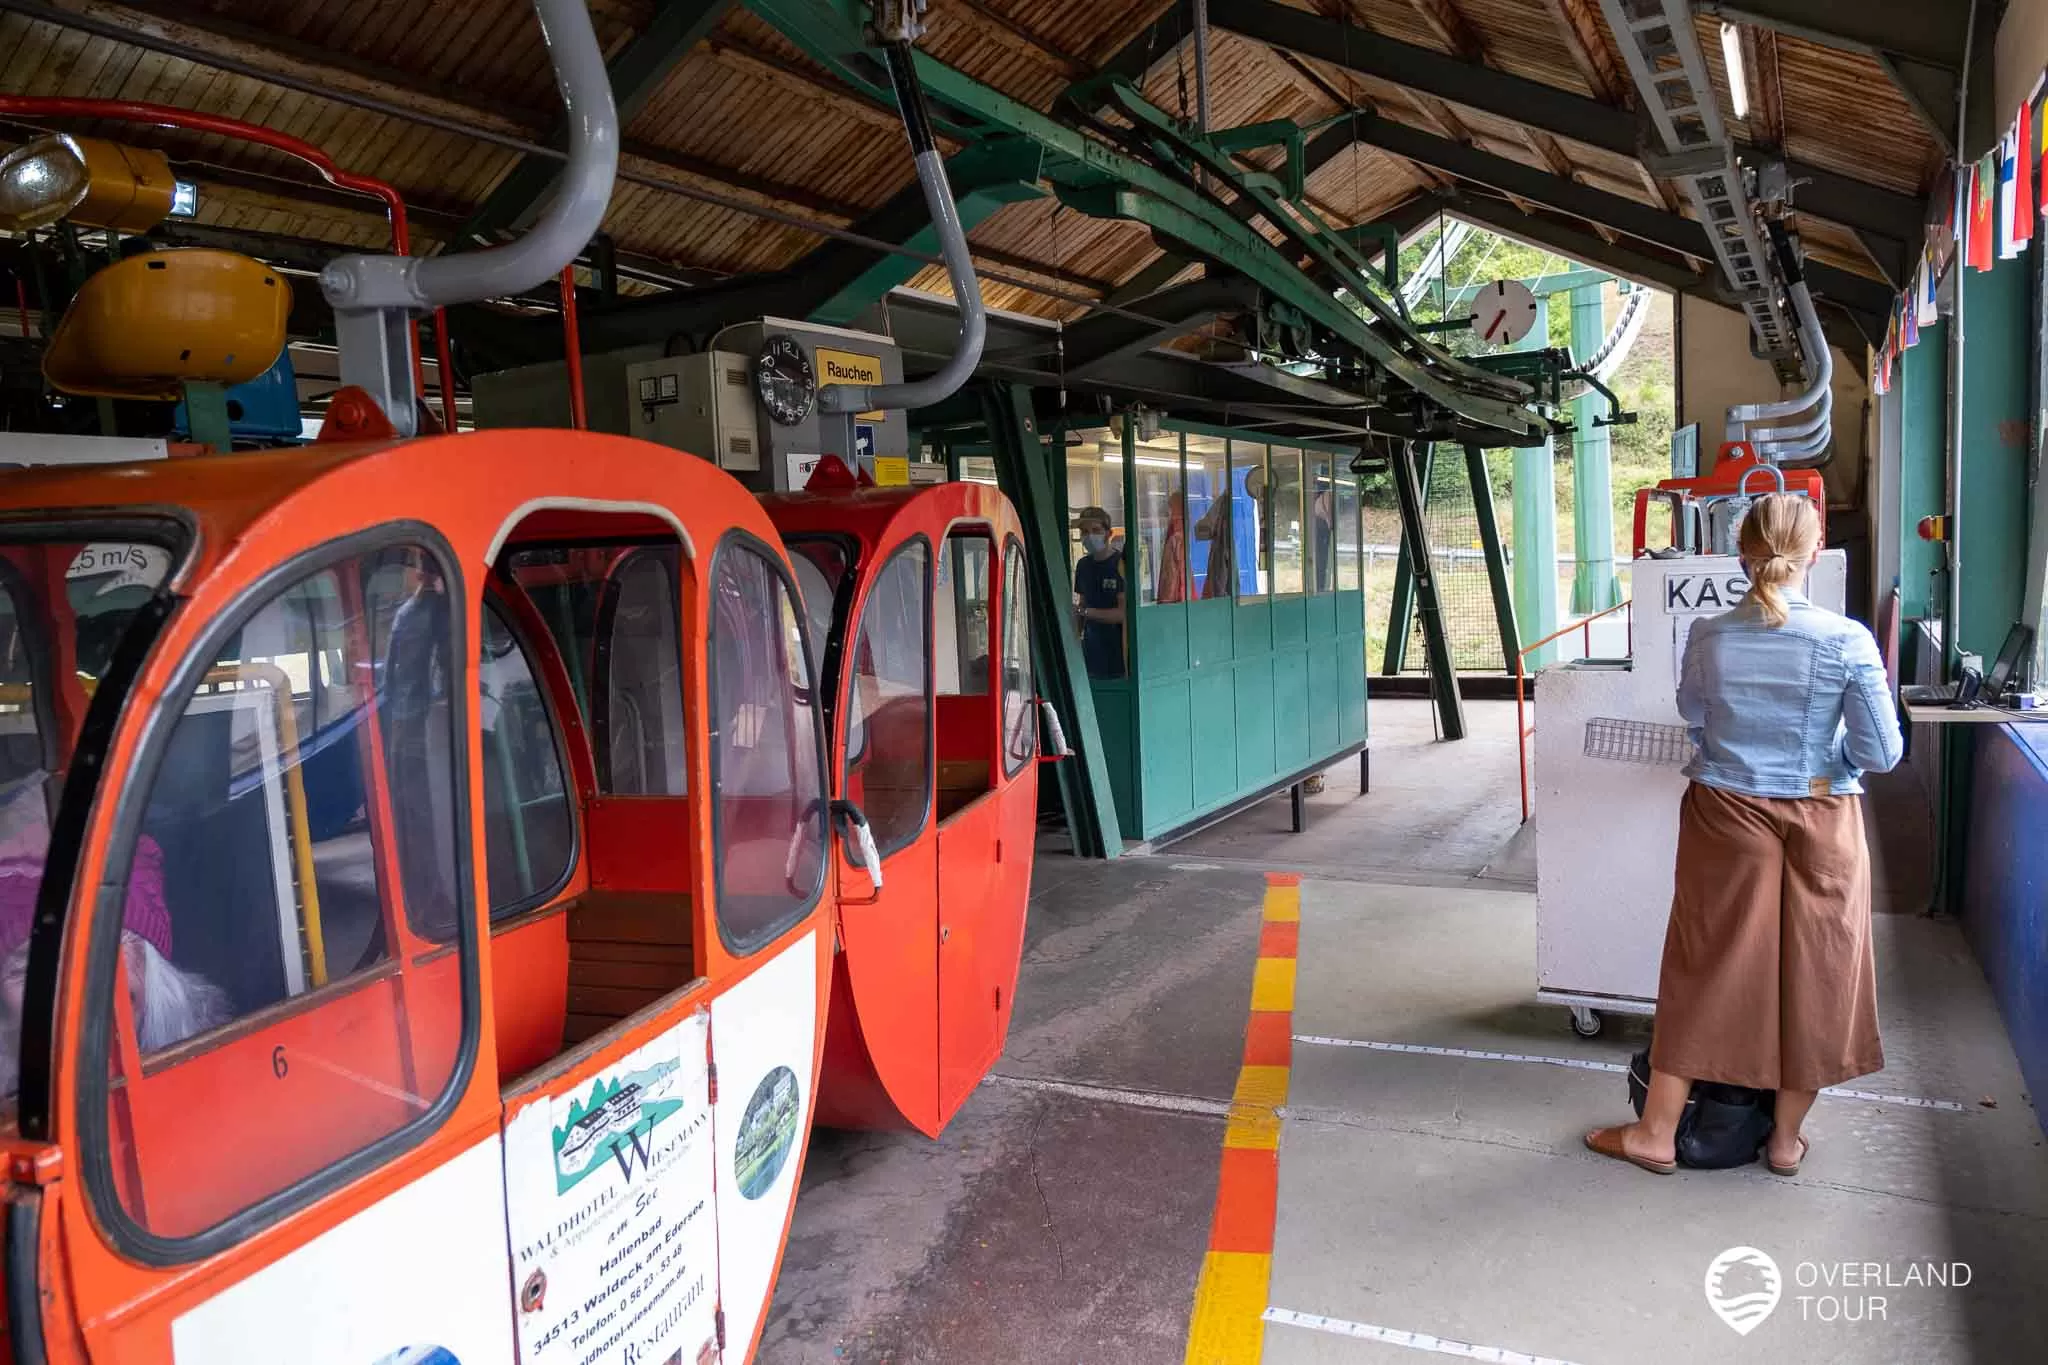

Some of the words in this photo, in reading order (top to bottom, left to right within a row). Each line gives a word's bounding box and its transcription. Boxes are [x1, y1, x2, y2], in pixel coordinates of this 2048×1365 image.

[772, 344, 780, 357] 11
[782, 341, 791, 353] 12
[802, 362, 809, 373] 2
[827, 361, 873, 382] Rauchen
[805, 379, 812, 390] 3
[797, 406, 804, 417] 5
[804, 396, 810, 405] 4
[786, 408, 794, 421] 6
[102, 544, 148, 570] m/s
[1668, 577, 1752, 609] KAS
[272, 1045, 288, 1080] 6
[634, 1188, 659, 1217] See
[520, 1186, 618, 1262] WALDHOTEL
[599, 1216, 663, 1277] Hallenbad
[533, 1309, 580, 1355] 34513
[584, 1262, 643, 1313] Waldeck
[646, 1242, 662, 1264] am
[664, 1199, 704, 1245] Edersee
[571, 1309, 618, 1350] Telefon:
[619, 1298, 628, 1312] 0
[630, 1286, 641, 1305] 56
[643, 1273, 654, 1296] 23
[660, 1255, 670, 1273] 53
[580, 1265, 686, 1365] aldhotel-wiesemann.de
